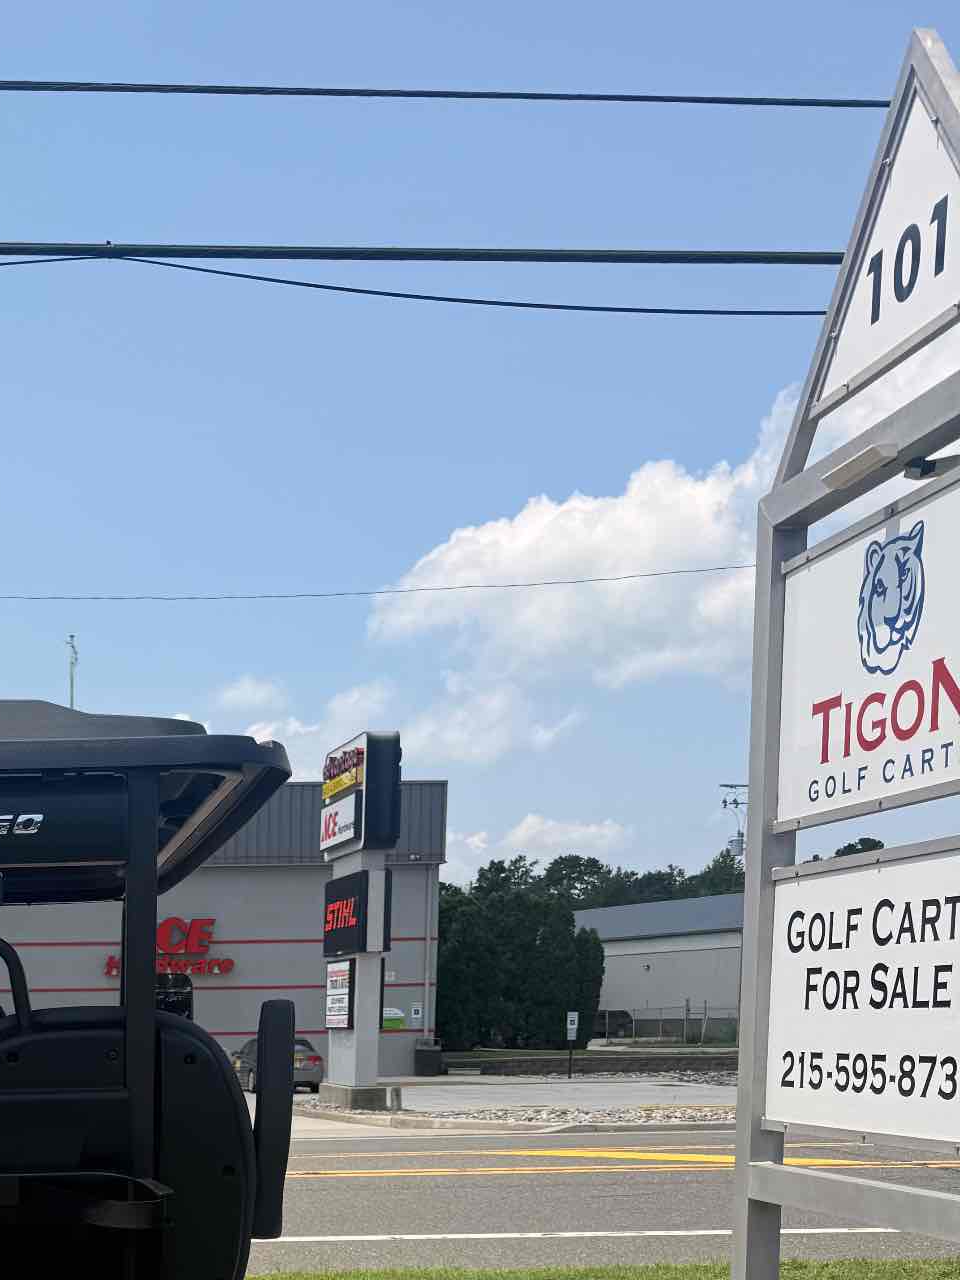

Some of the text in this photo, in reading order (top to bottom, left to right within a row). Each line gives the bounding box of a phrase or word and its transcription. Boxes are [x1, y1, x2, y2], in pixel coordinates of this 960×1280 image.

[866, 194, 949, 326] 101
[808, 765, 868, 802] GOLF
[156, 916, 217, 953] CE
[325, 897, 358, 932] STIHL
[787, 908, 863, 953] GOLF
[104, 955, 235, 977] Hdware
[804, 963, 953, 1011] FOR SALE
[780, 1051, 958, 1100] 215-595-873
